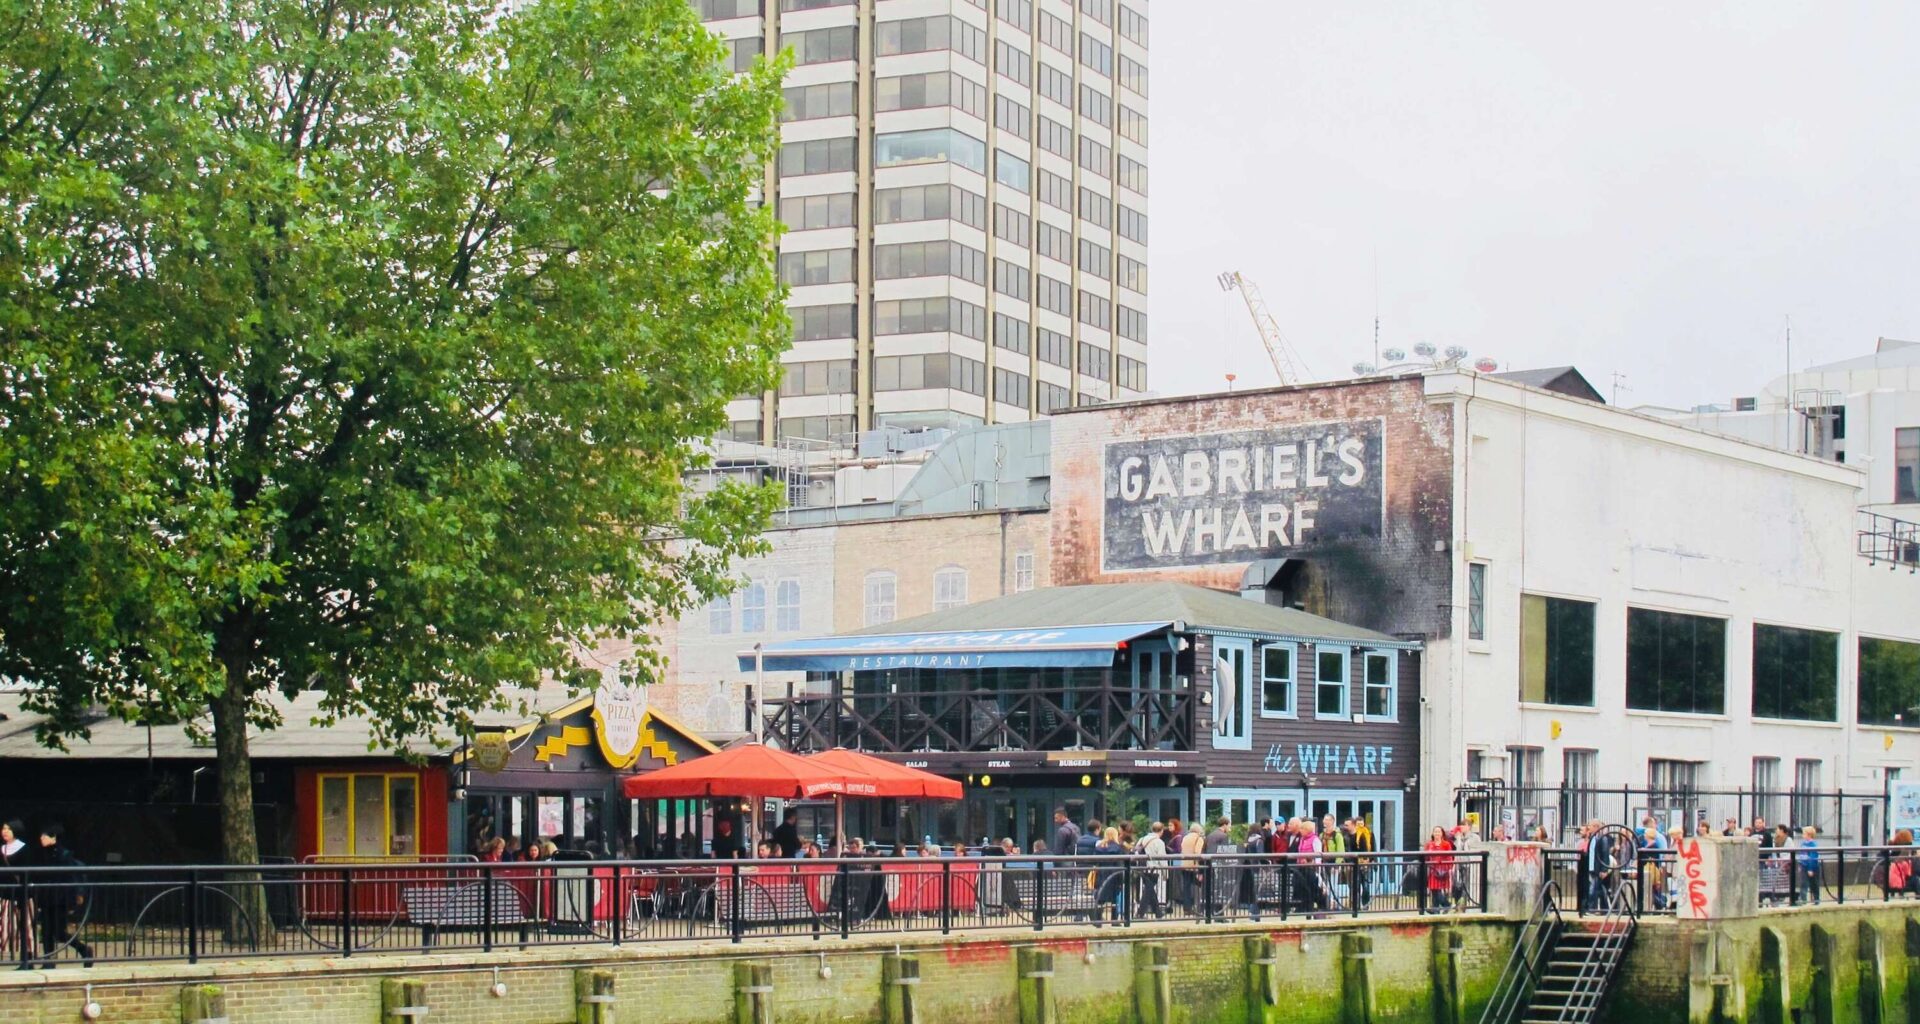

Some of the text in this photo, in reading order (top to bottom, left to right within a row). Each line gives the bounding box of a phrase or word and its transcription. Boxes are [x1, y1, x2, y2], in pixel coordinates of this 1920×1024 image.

[1119, 436, 1365, 501] GABRIEL'S
[1141, 500, 1319, 555] WHARF
[849, 653, 986, 669] RESTAURANT
[607, 703, 636, 721] PIZZA
[905, 760, 928, 768] SALAD
[987, 760, 1011, 768] STEAK
[1058, 759, 1092, 767] BURGERS
[1297, 743, 1394, 775] WHARF
